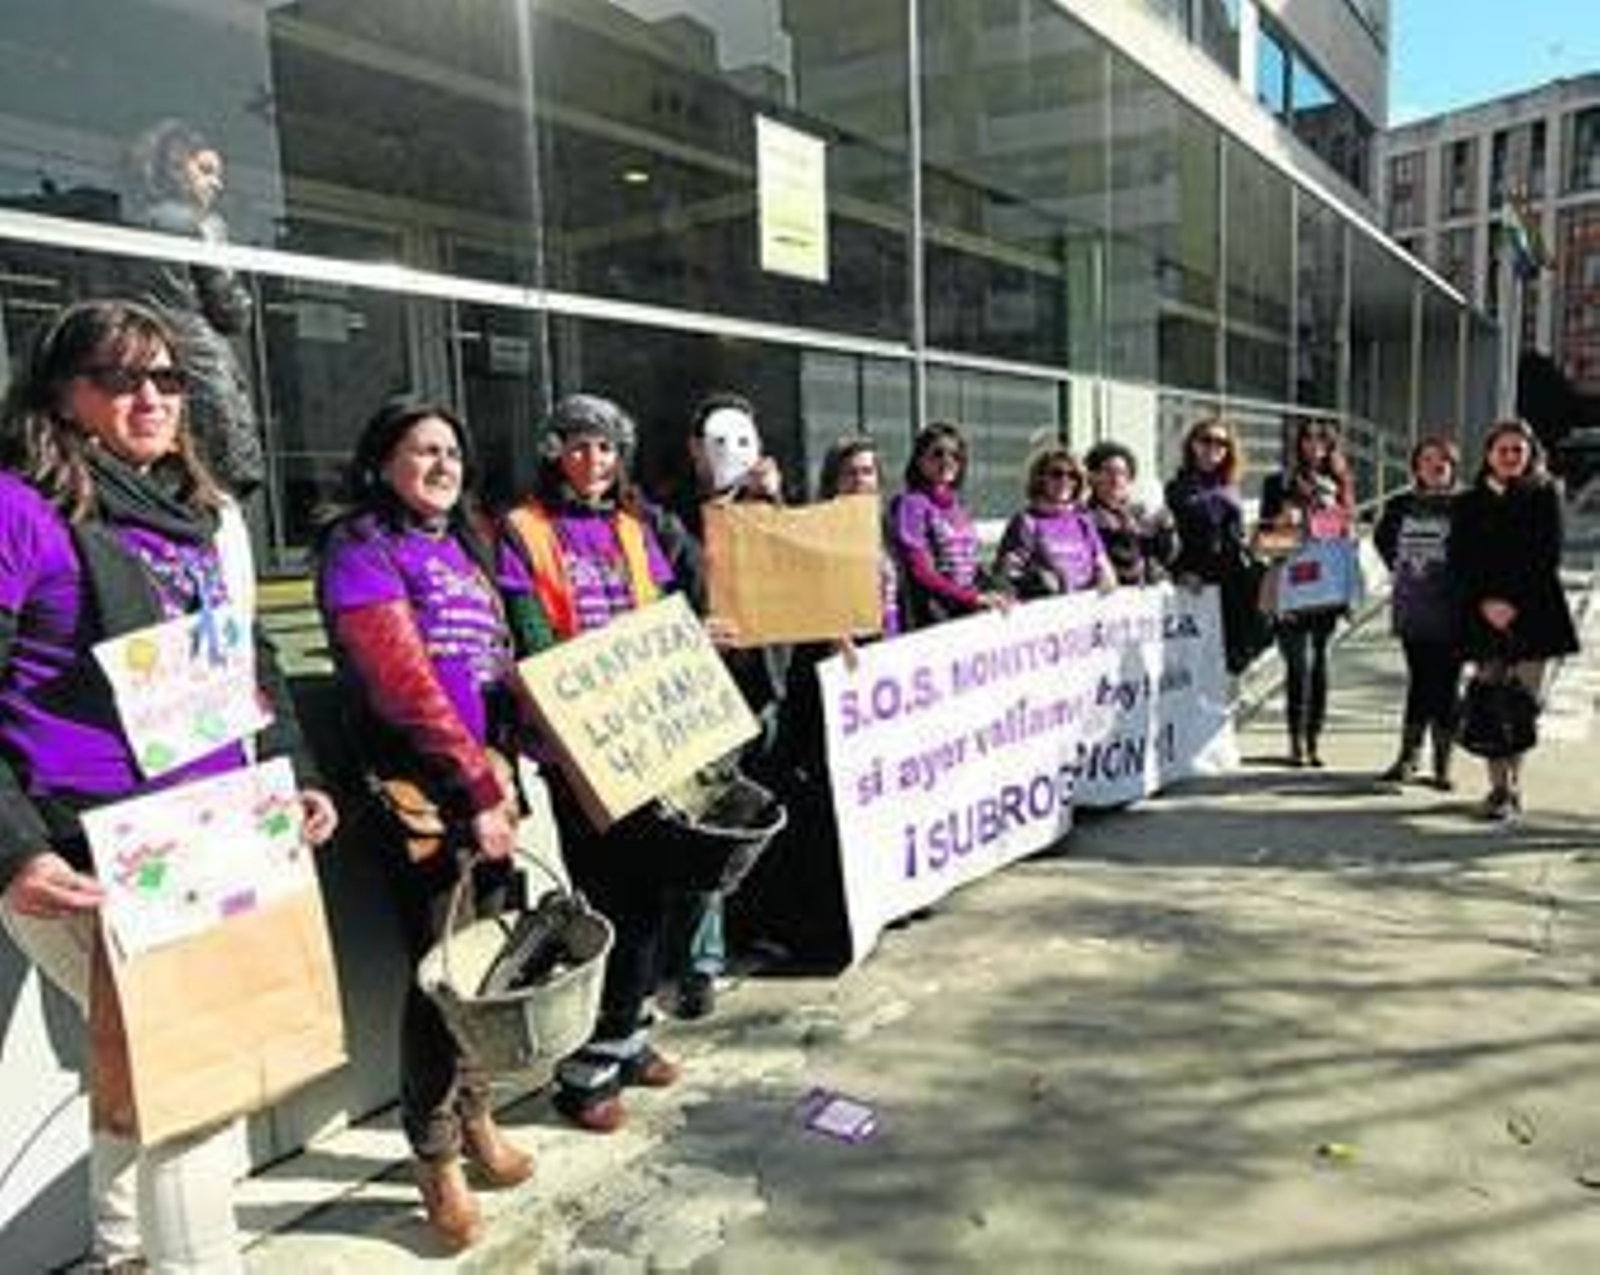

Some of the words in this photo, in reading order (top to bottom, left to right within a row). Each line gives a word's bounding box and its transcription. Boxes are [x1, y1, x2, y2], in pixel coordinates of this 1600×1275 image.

[583, 662, 715, 749] LUCIANO
[838, 667, 942, 736] S.O.S.
[857, 756, 884, 807] si
[899, 738, 968, 791] ayer
